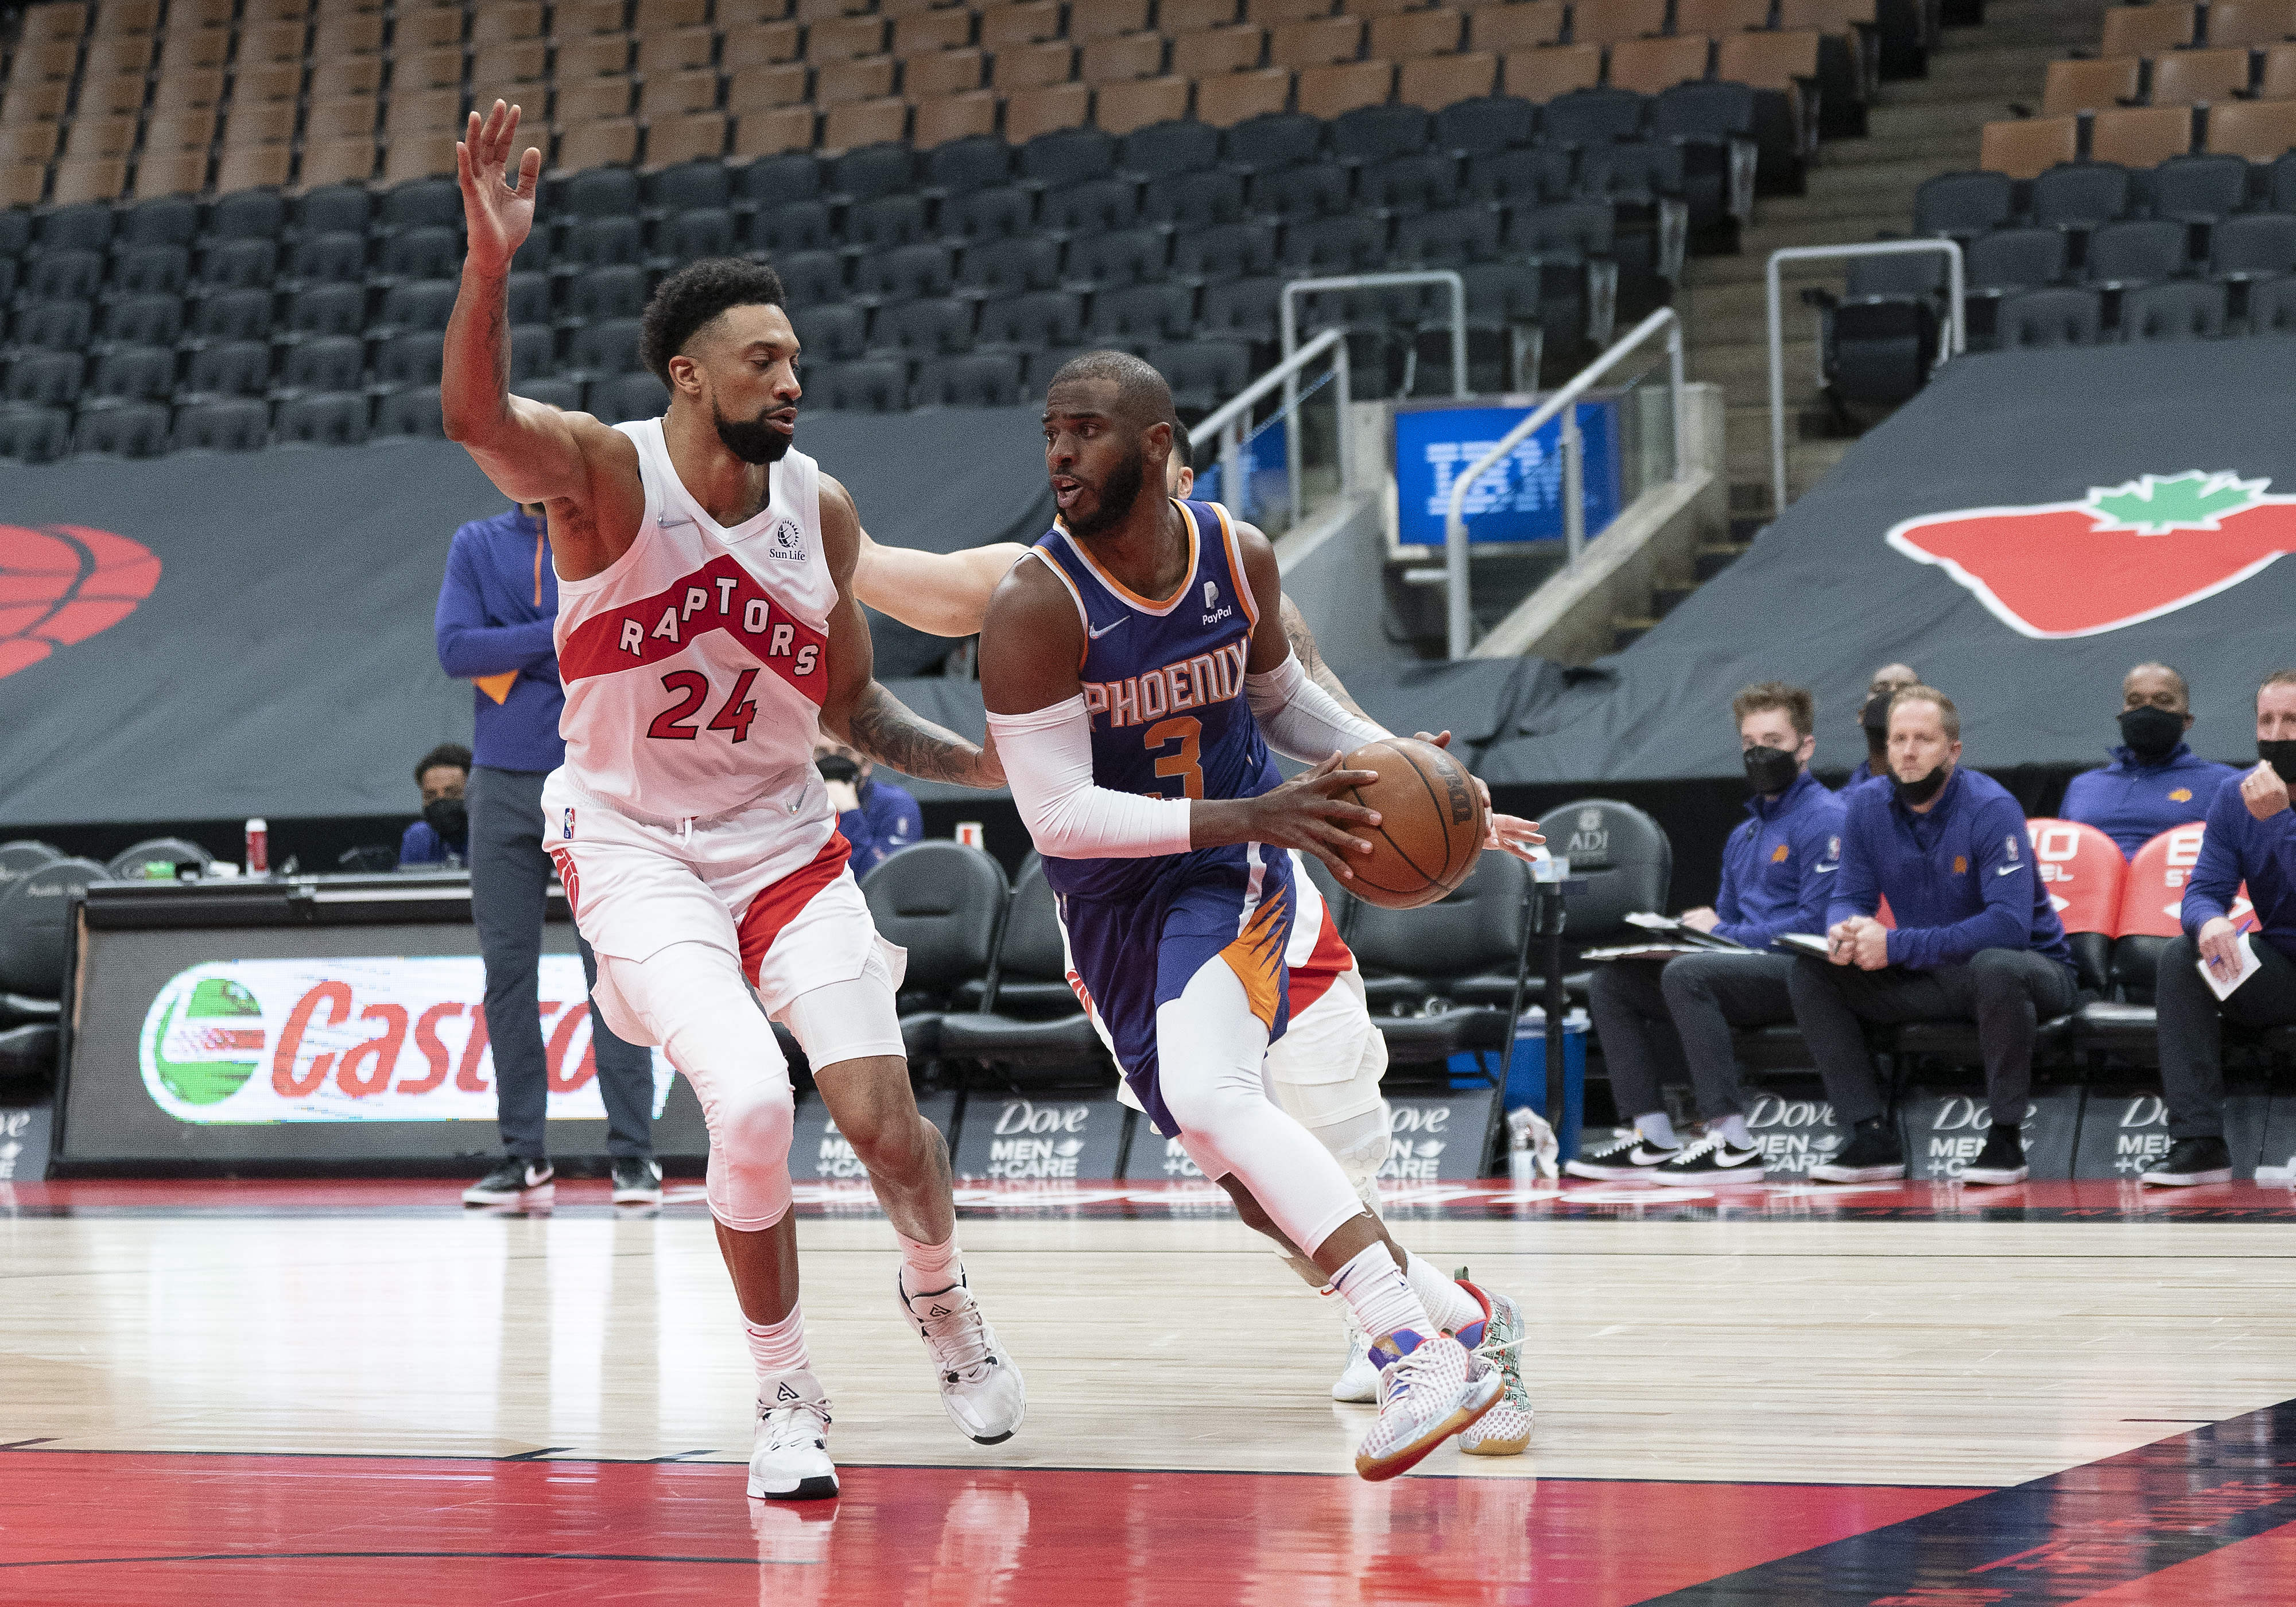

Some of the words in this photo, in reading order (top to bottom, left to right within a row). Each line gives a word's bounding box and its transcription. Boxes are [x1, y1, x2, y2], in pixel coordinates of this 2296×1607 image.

[769, 548, 788, 559] Sun
[789, 550, 805, 561] Life
[618, 576, 821, 676] RAPTORS
[1202, 605, 1232, 626] PayPal
[646, 667, 761, 744] 24
[1144, 715, 1205, 801] 3
[272, 980, 598, 1099] Casto
[995, 1098, 1089, 1135] Dove
[1390, 1107, 1451, 1133] ove
[990, 1138, 1054, 1161] MEN
[988, 1157, 1079, 1178] +CARE
